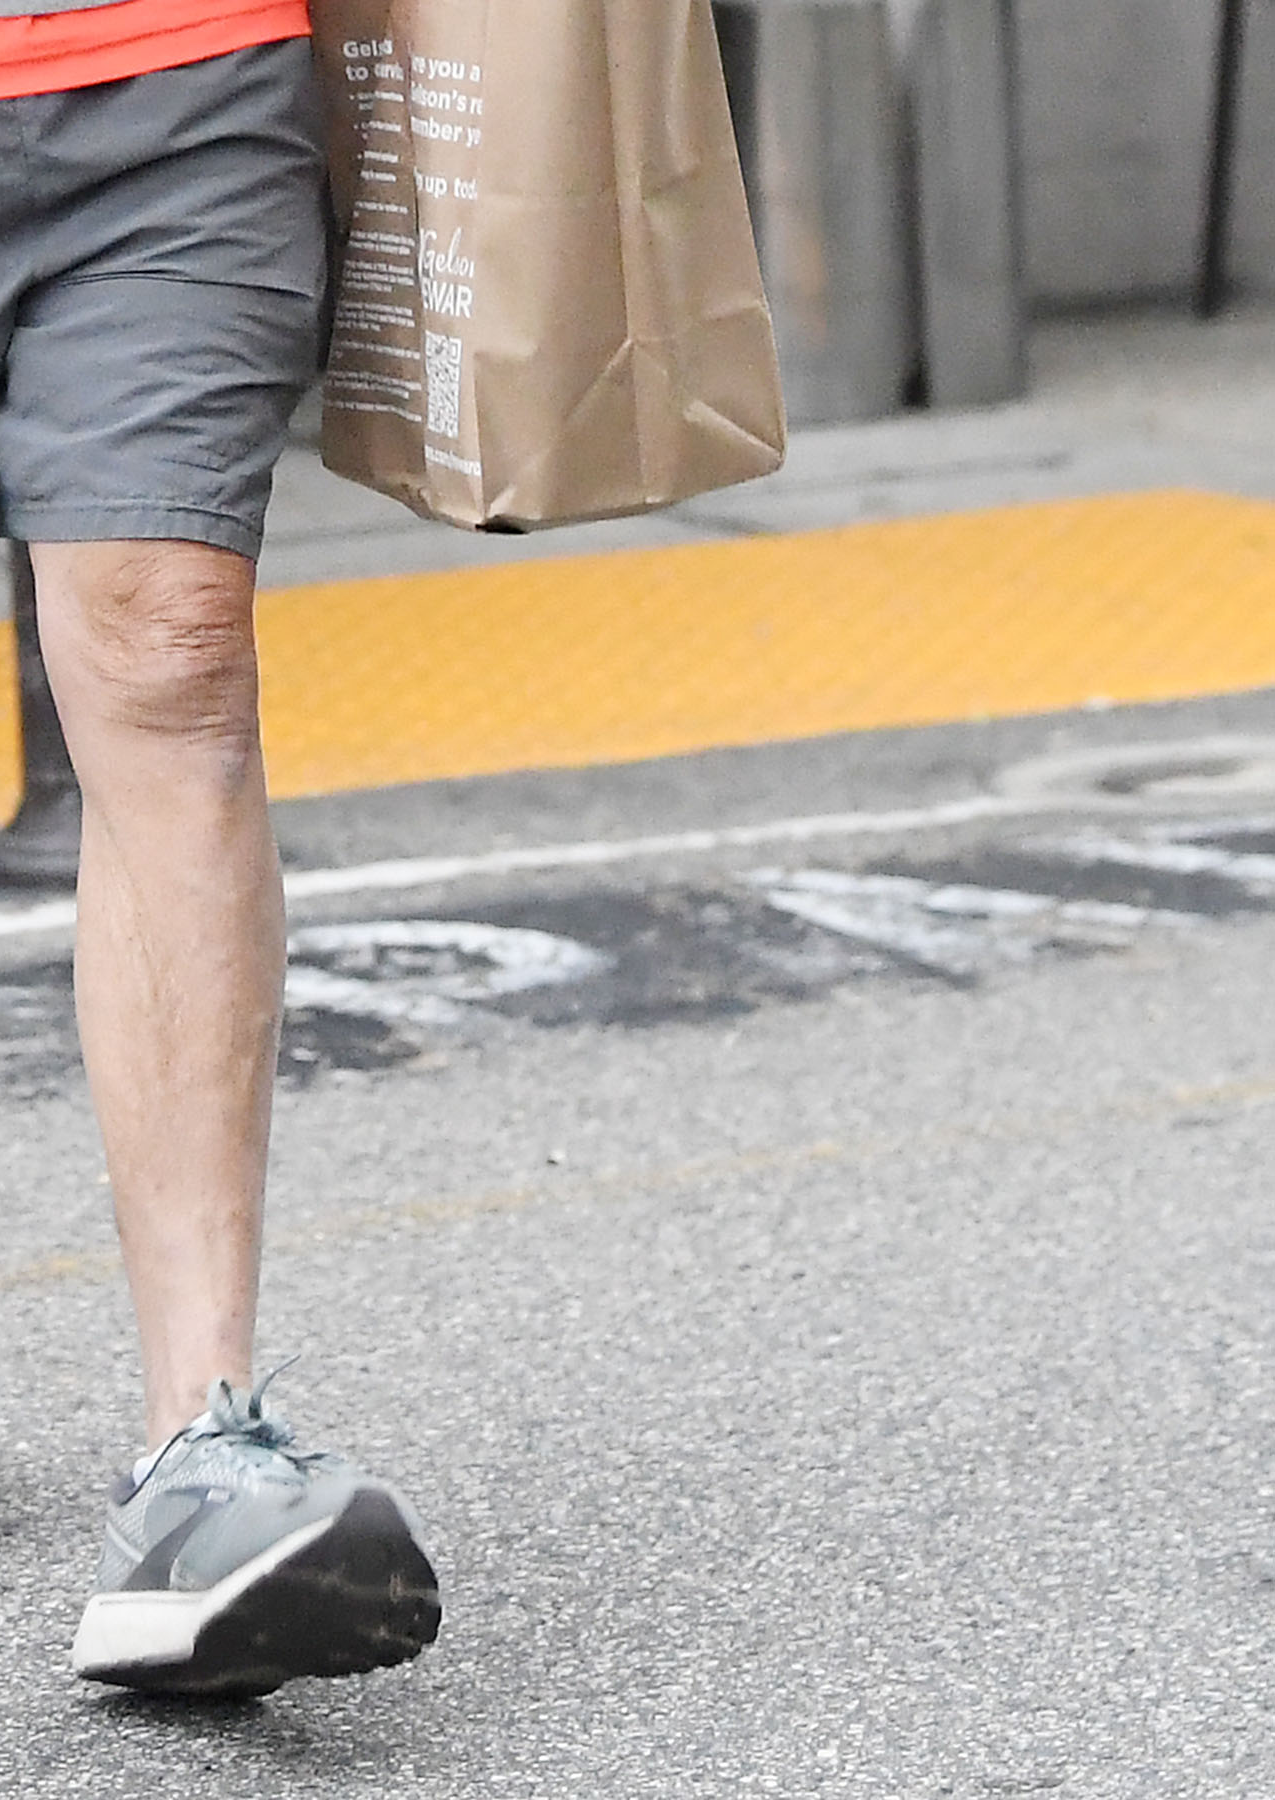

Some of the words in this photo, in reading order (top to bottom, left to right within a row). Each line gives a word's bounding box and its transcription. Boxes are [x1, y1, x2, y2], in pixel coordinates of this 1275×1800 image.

[346, 65, 369, 81] to
[428, 58, 465, 80] you
[425, 176, 447, 198] up
